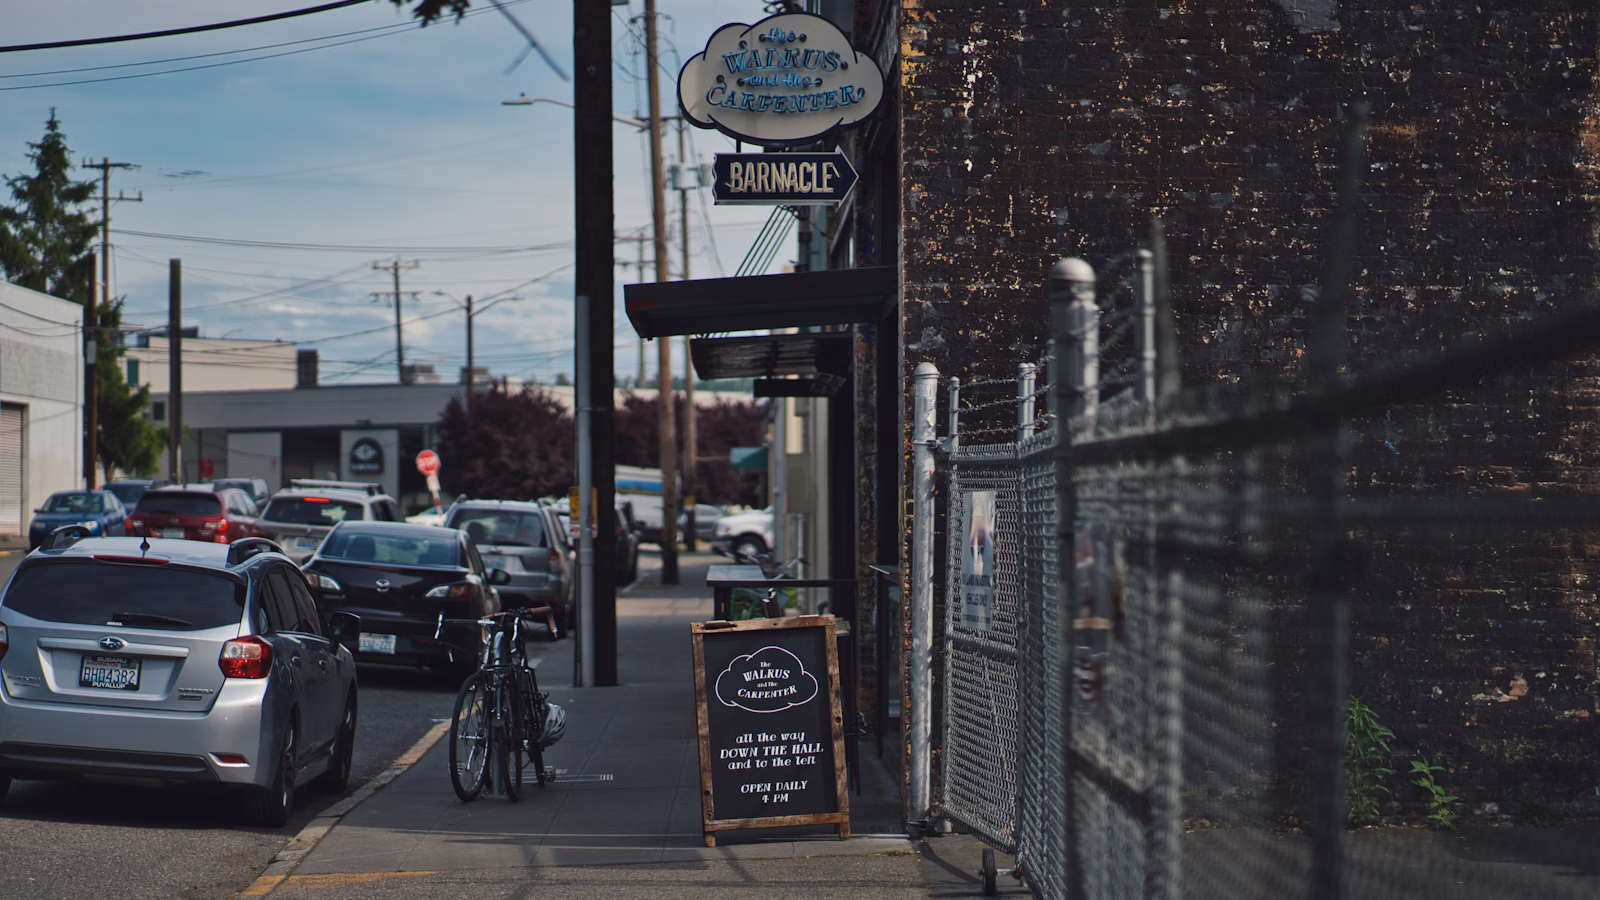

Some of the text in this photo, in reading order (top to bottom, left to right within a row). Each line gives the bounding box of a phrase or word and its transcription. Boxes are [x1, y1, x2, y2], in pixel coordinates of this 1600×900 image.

[767, 27, 797, 43] the
[721, 47, 842, 75] WALRUS
[746, 72, 812, 87] and the
[706, 83, 866, 115] CARPENTER
[729, 161, 836, 194] BARNACLE
[743, 669, 791, 682] WALRUS
[92, 681, 126, 689] PUYALLUP
[737, 685, 798, 699] CARPENTER
[736, 732, 805, 744] all the way
[720, 743, 823, 759] DOWN THE HALL
[728, 755, 816, 770] and to the left
[740, 780, 808, 793] OPEN DAILY
[761, 793, 789, 803] 4 PM
